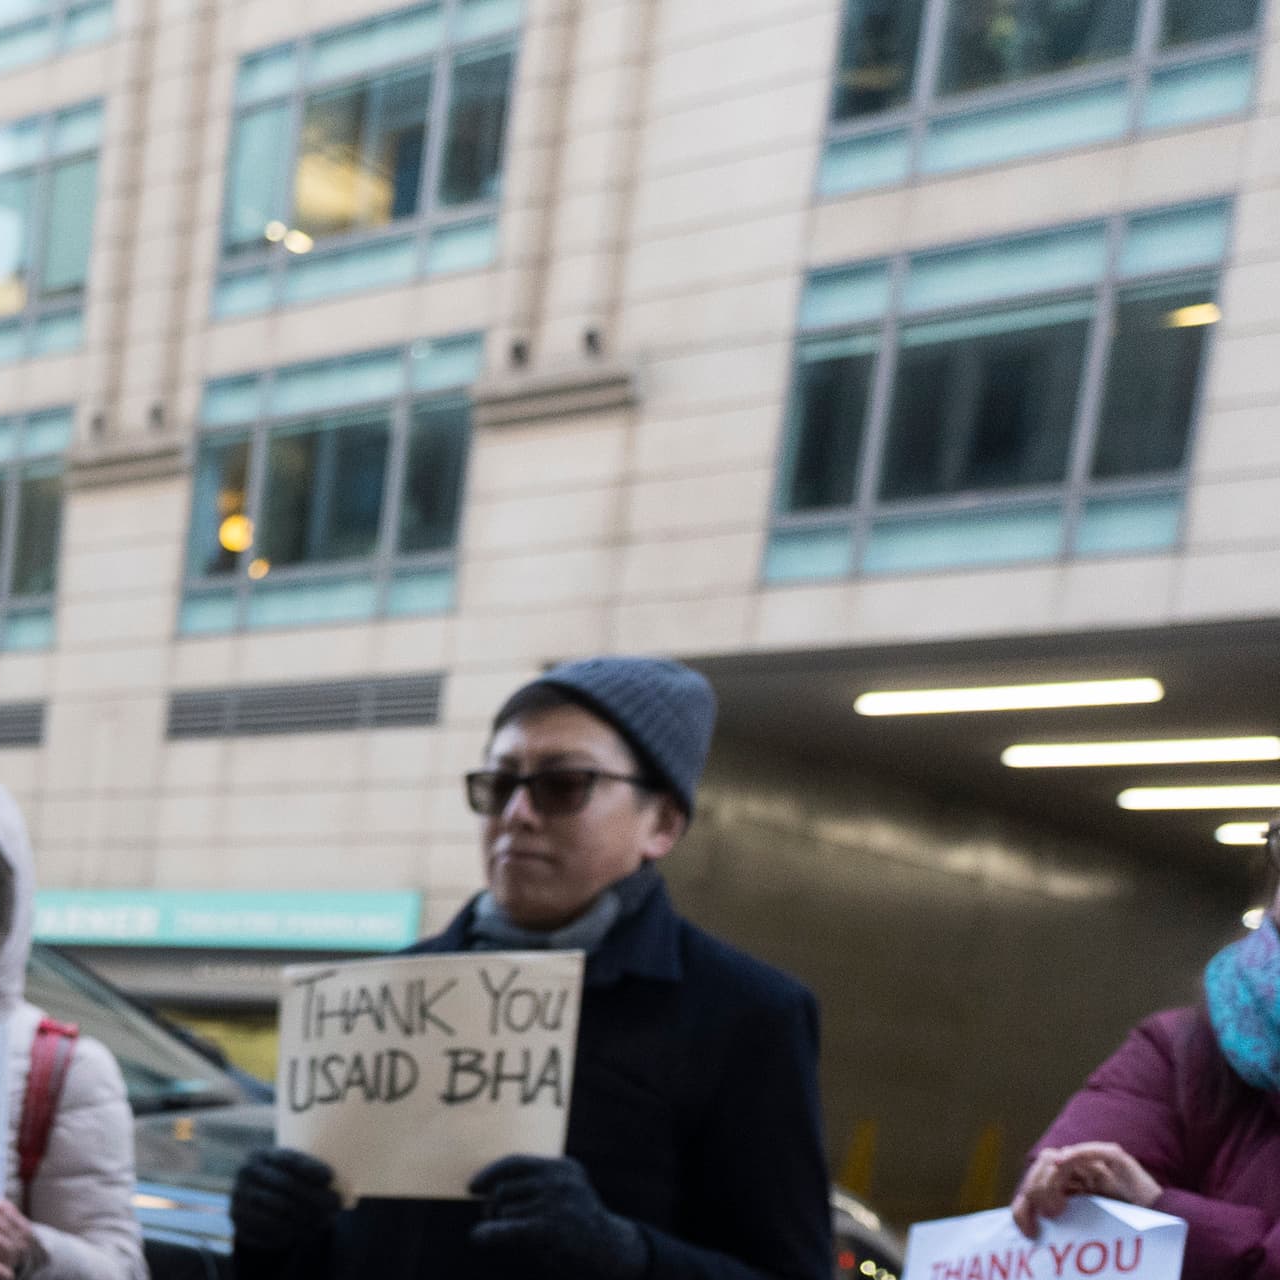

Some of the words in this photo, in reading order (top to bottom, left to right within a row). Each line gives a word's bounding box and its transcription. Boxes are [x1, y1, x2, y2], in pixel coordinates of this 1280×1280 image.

[292, 969, 457, 1041] THANK
[478, 966, 568, 1034] YOU
[287, 1049, 420, 1113] USAID
[439, 1047, 565, 1109] BHA
[1049, 1234, 1144, 1278] YOU
